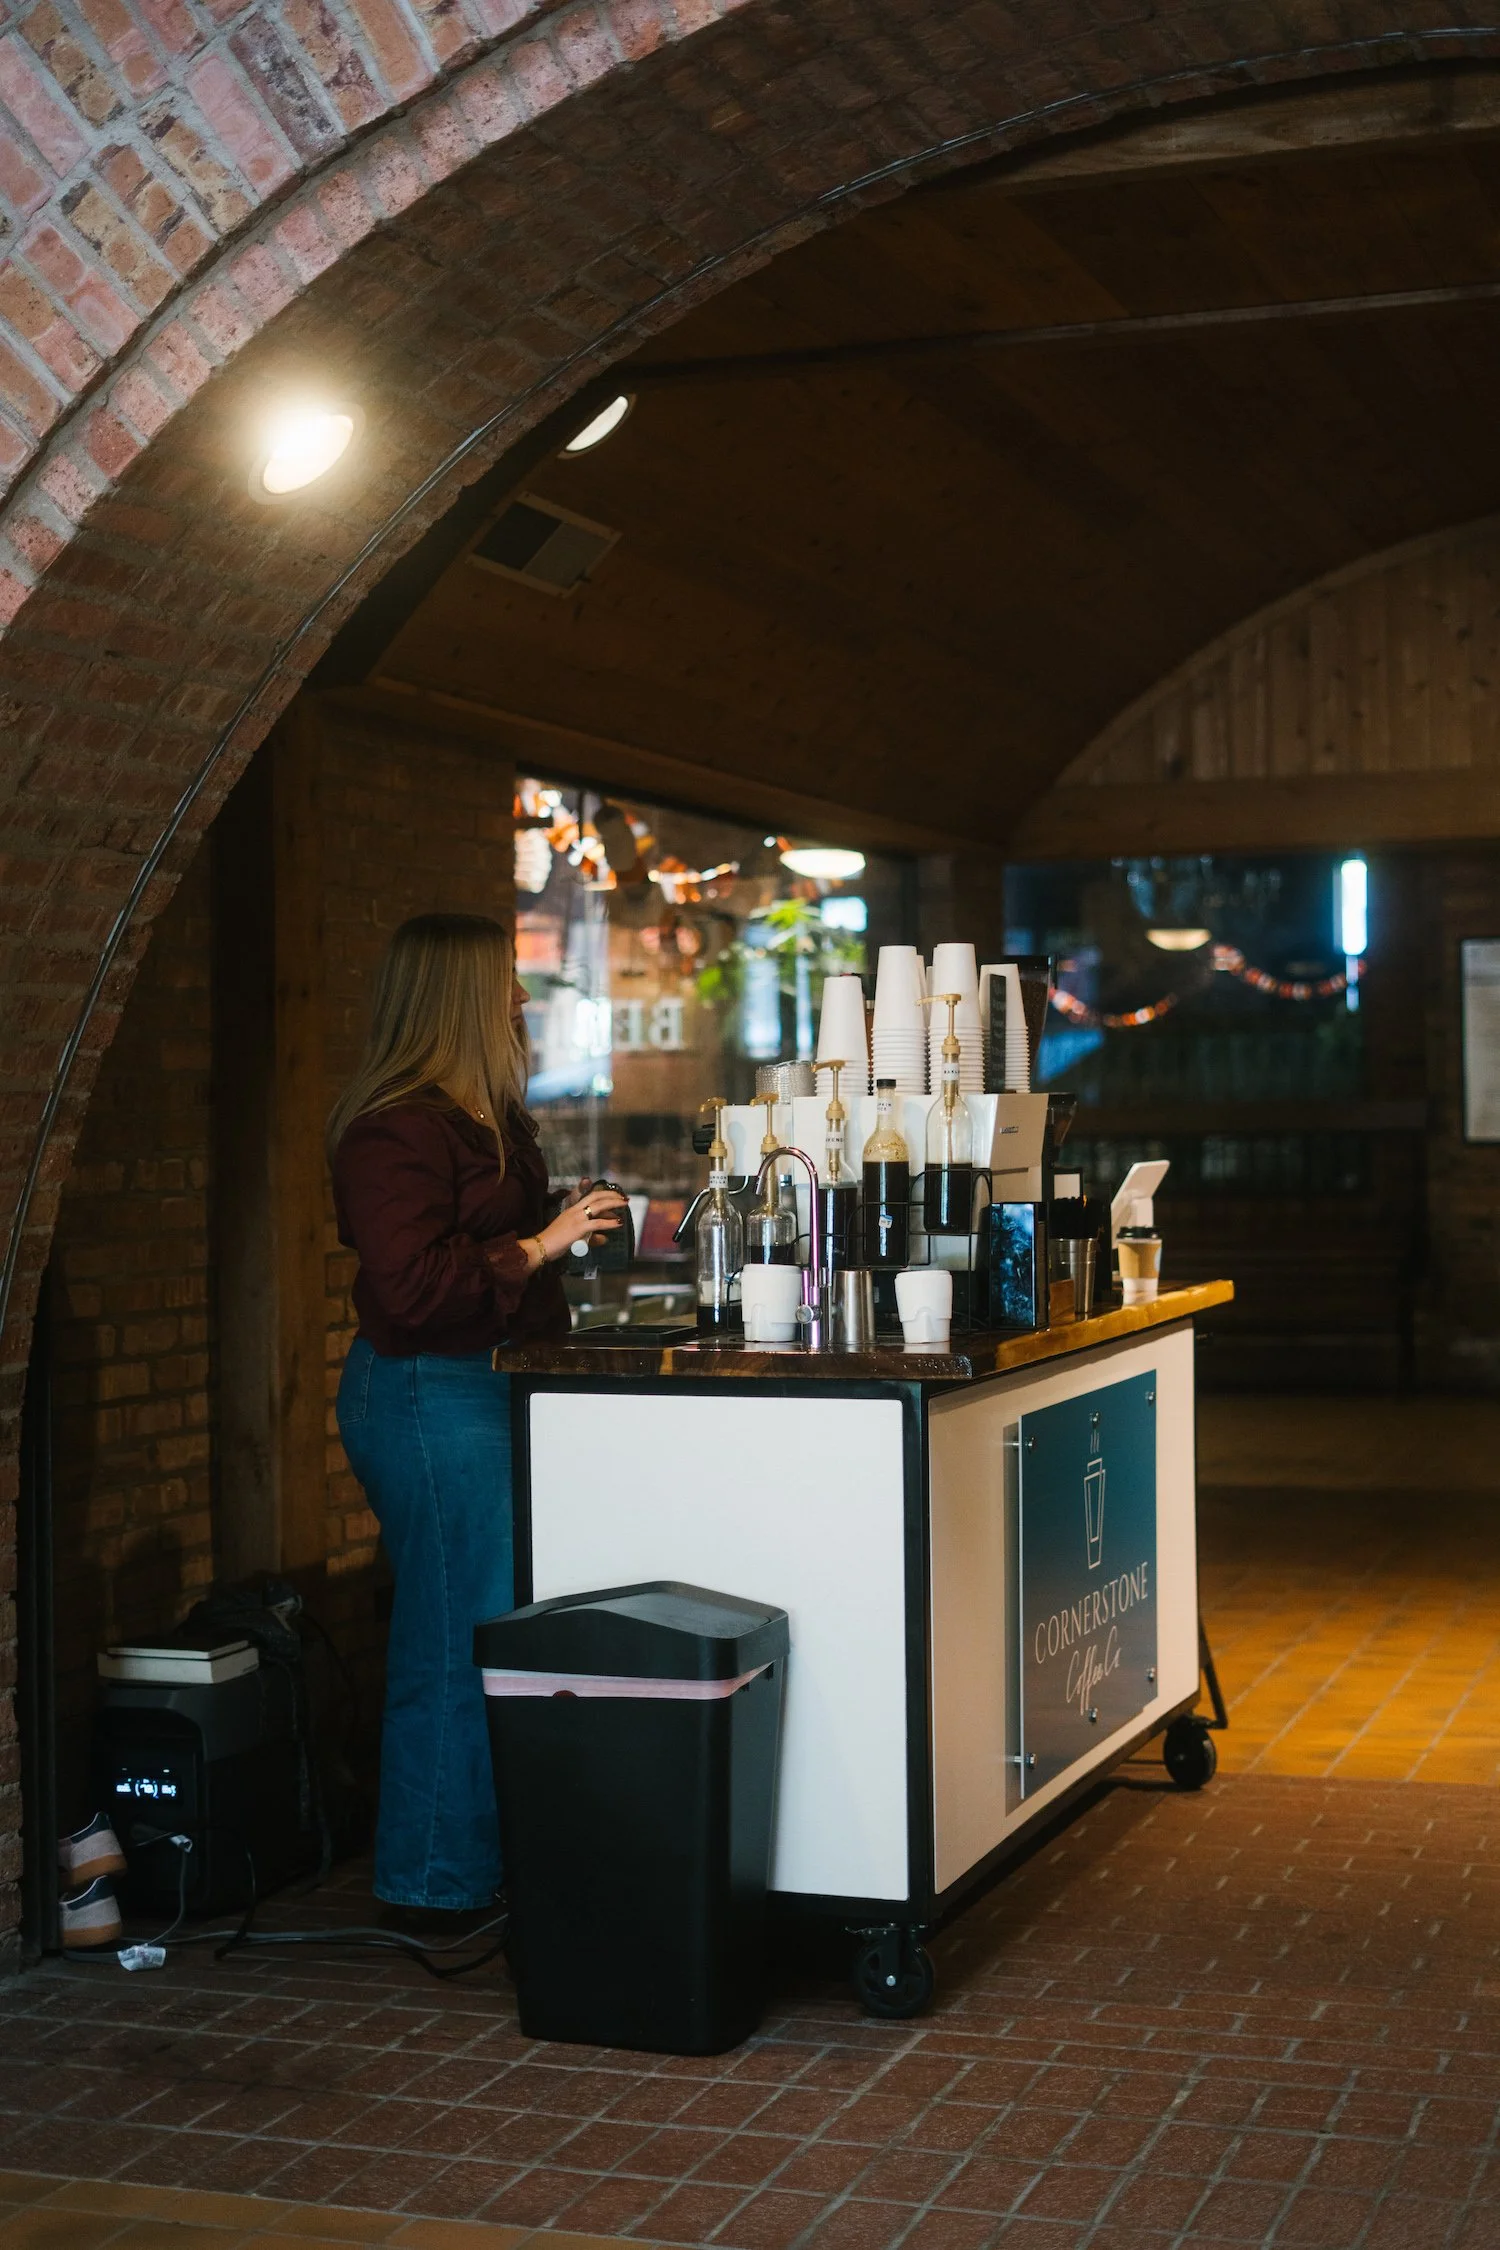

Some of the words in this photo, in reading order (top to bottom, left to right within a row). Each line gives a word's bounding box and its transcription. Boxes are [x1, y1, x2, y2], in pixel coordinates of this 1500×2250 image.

[1035, 1561, 1148, 1665] CORNERSTONE
[1066, 1644, 1104, 1716] Coffee
[1104, 1625, 1122, 1676] Co
